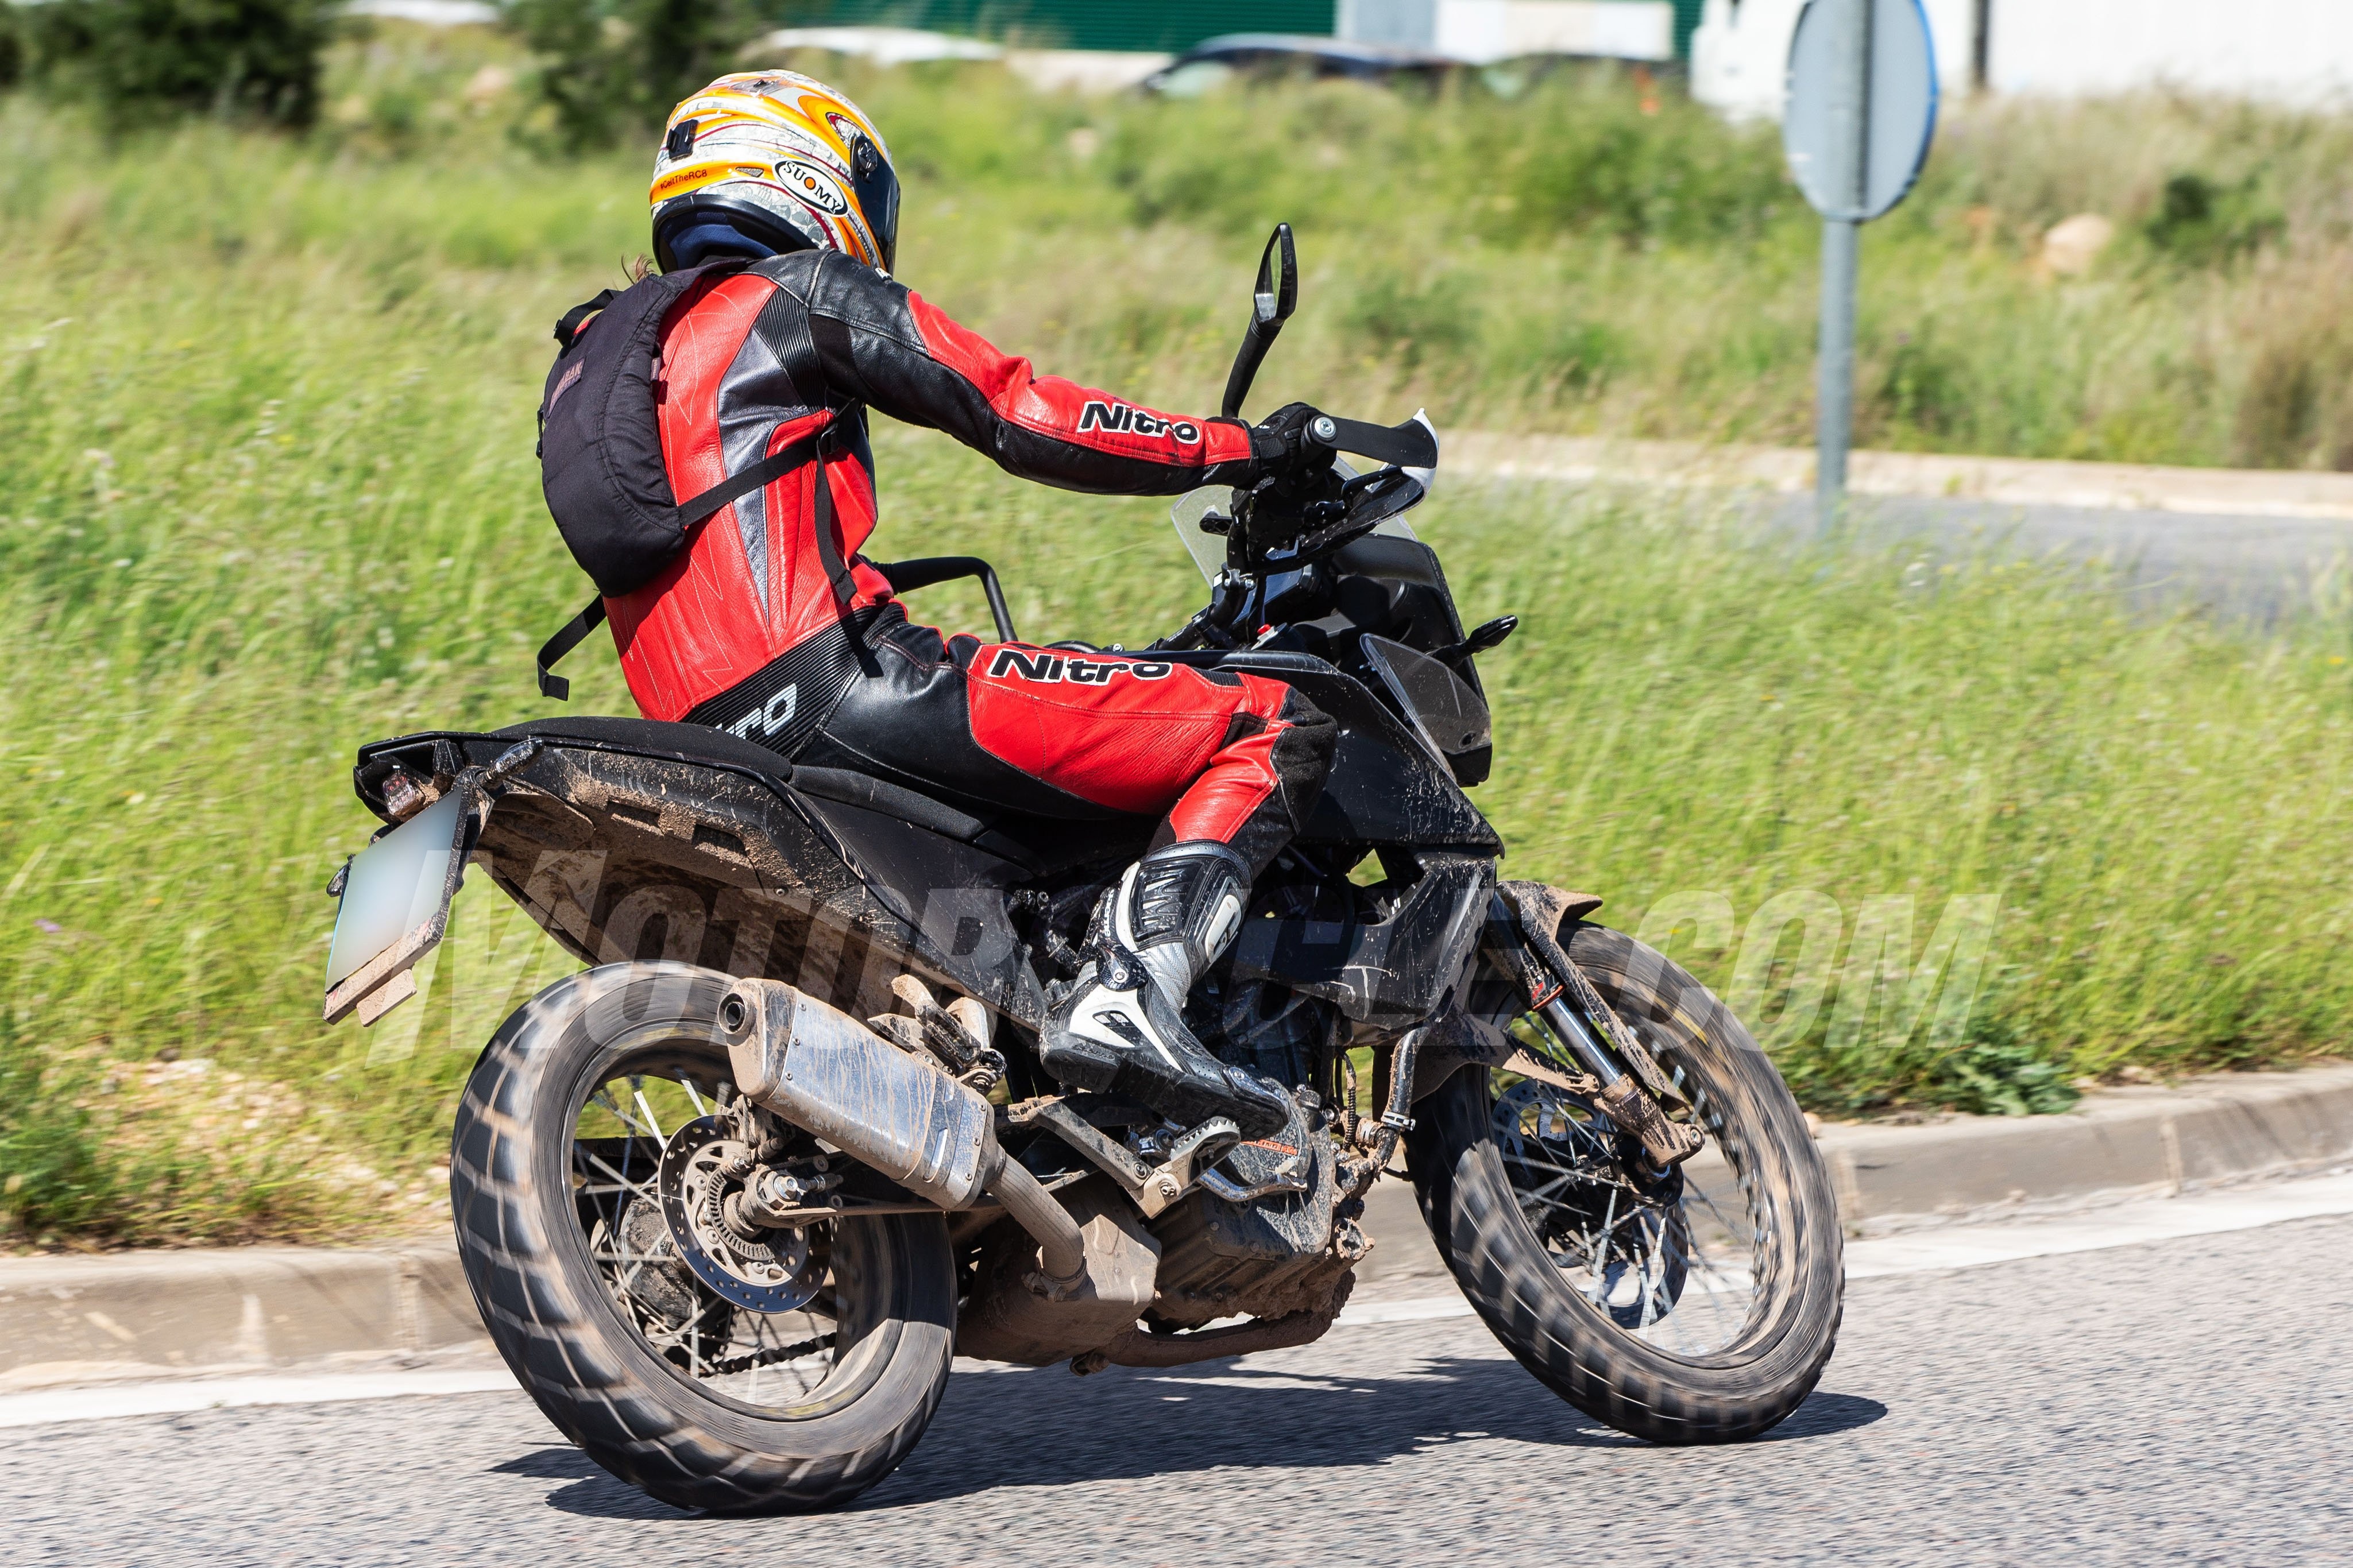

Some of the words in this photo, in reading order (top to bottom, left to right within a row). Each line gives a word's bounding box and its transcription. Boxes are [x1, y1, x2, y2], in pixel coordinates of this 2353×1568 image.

[783, 161, 841, 213] SUOMY
[1078, 401, 1200, 444] Nitro
[987, 648, 1173, 686] Nitro
[1104, 889, 1115, 937] gaerne
